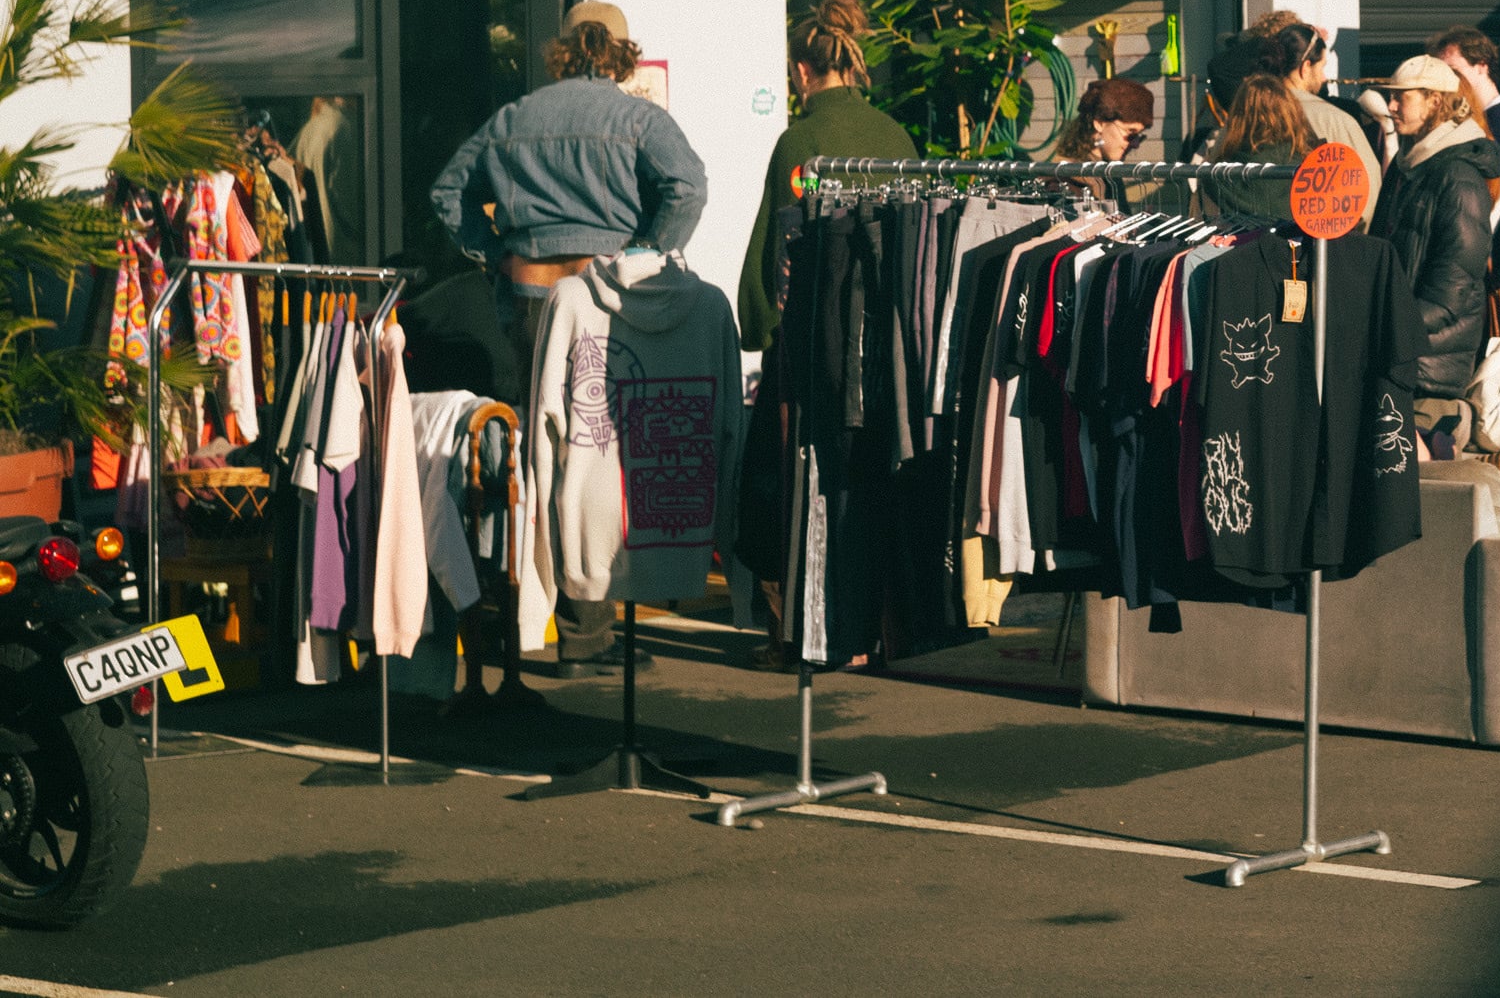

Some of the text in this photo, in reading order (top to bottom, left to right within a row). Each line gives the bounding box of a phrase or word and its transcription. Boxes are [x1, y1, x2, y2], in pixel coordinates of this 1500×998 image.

[1317, 147, 1345, 163] SALE
[1295, 165, 1362, 193] 50% OFF
[1299, 195, 1363, 215] RED DOT
[1305, 216, 1355, 234] GARMENT
[76, 634, 170, 693] C4QNP
